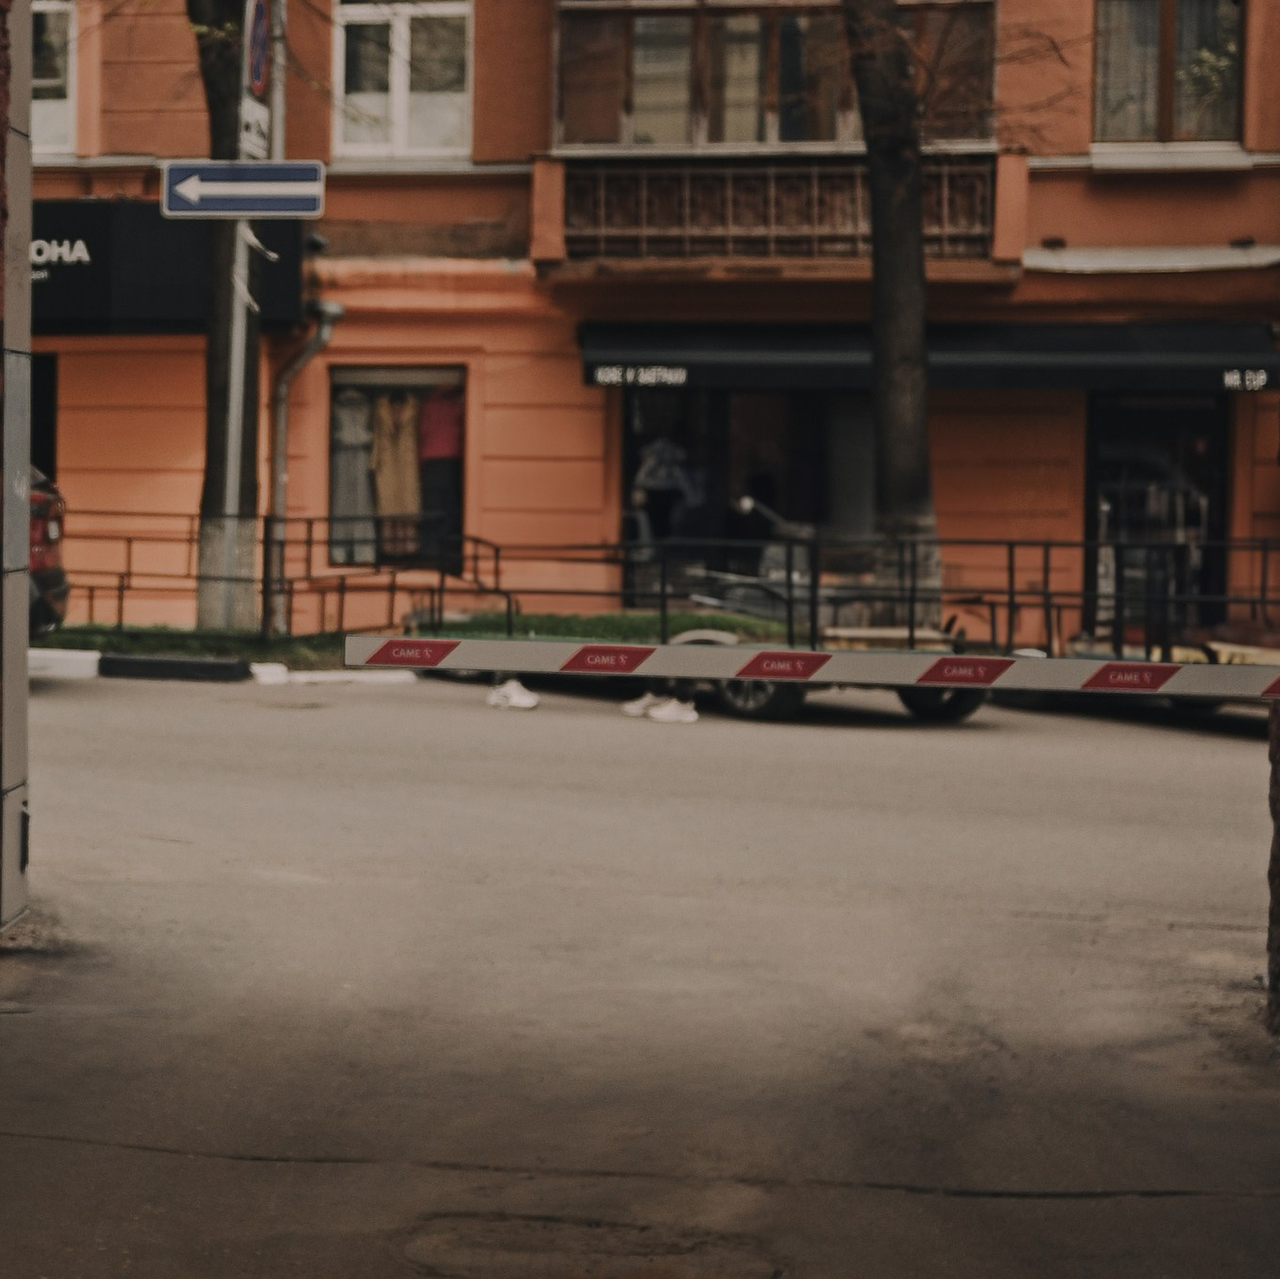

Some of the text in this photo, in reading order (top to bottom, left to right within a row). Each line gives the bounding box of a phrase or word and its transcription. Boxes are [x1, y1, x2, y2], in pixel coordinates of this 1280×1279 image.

[392, 648, 421, 659] CAME
[586, 654, 616, 665] CAME
[763, 660, 791, 671] CAME
[944, 665, 974, 677] CAME
[1109, 671, 1140, 683] CAME
